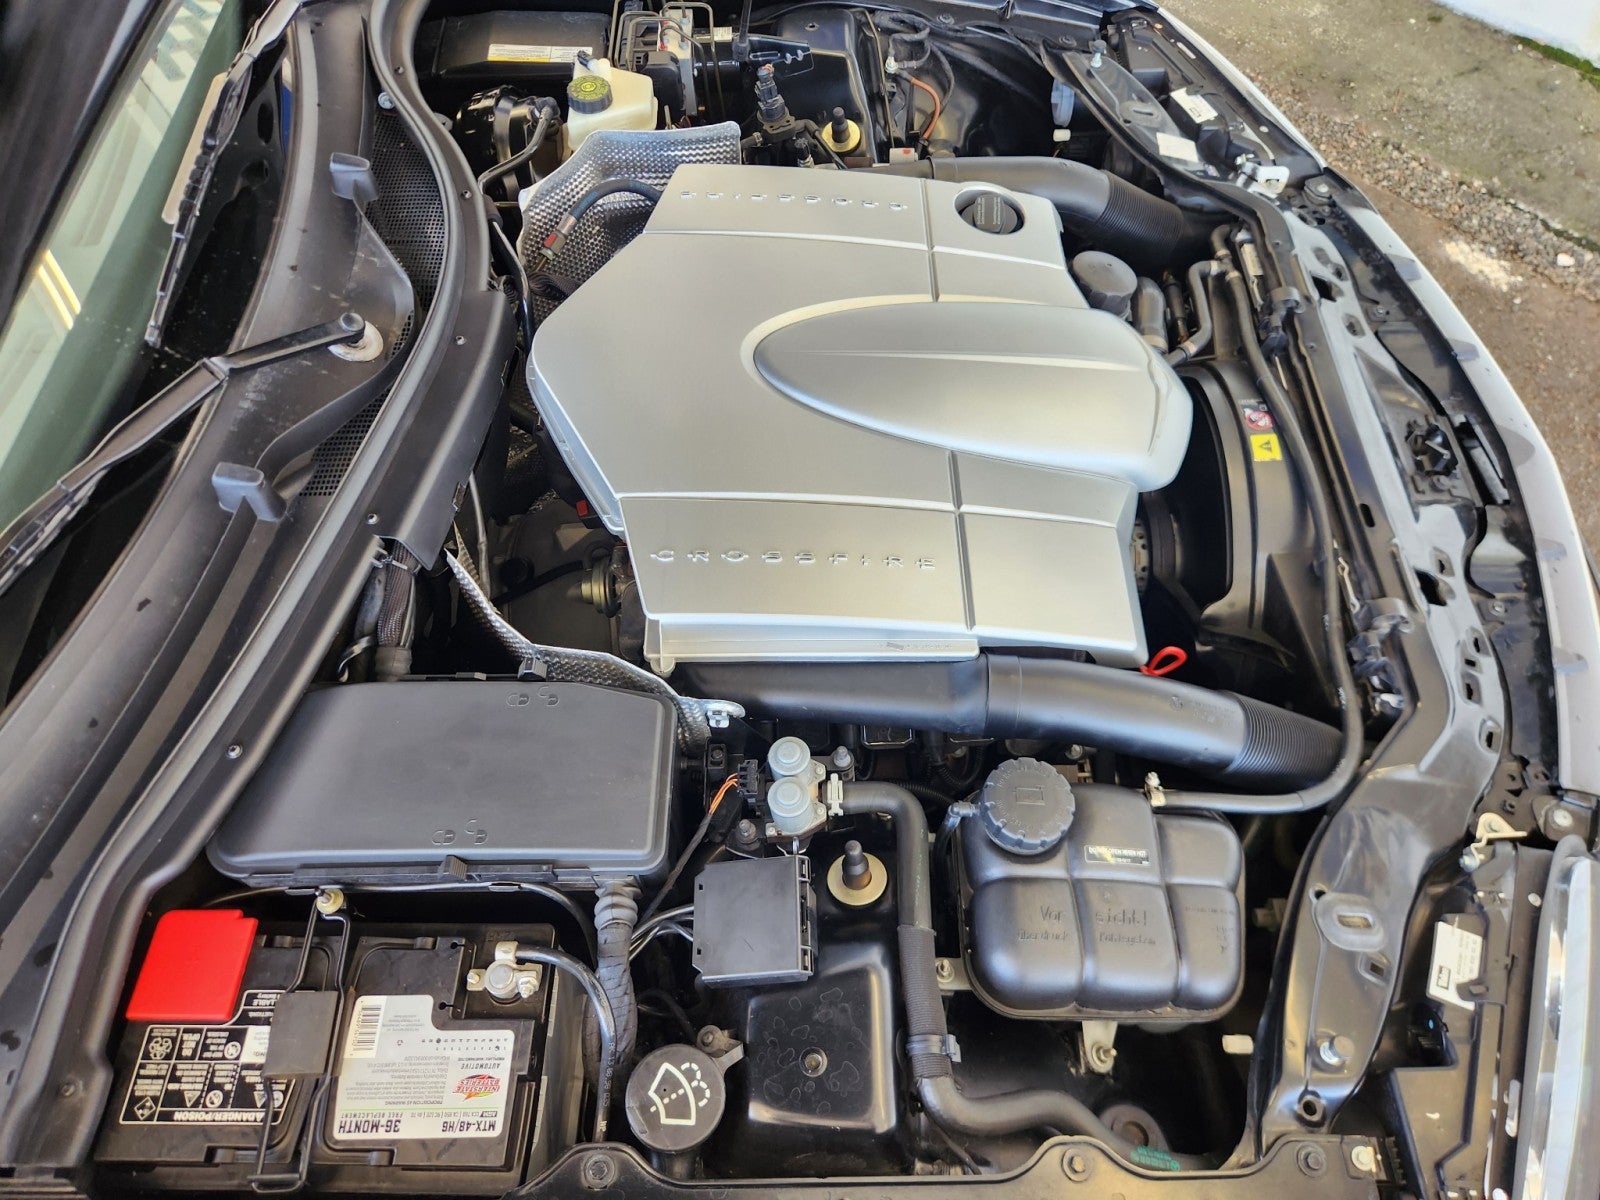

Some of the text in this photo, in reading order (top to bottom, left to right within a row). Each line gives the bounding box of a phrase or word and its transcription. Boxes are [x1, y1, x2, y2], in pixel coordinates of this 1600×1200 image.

[650, 549, 936, 570] CROSSFIRE
[1039, 904, 1067, 921] Vor
[459, 1078, 501, 1087] BATTERIES
[455, 1085, 501, 1094] INTERSTATE
[173, 1111, 255, 1122] DANGER/POISON
[338, 1118, 402, 1134] 36-MONTH
